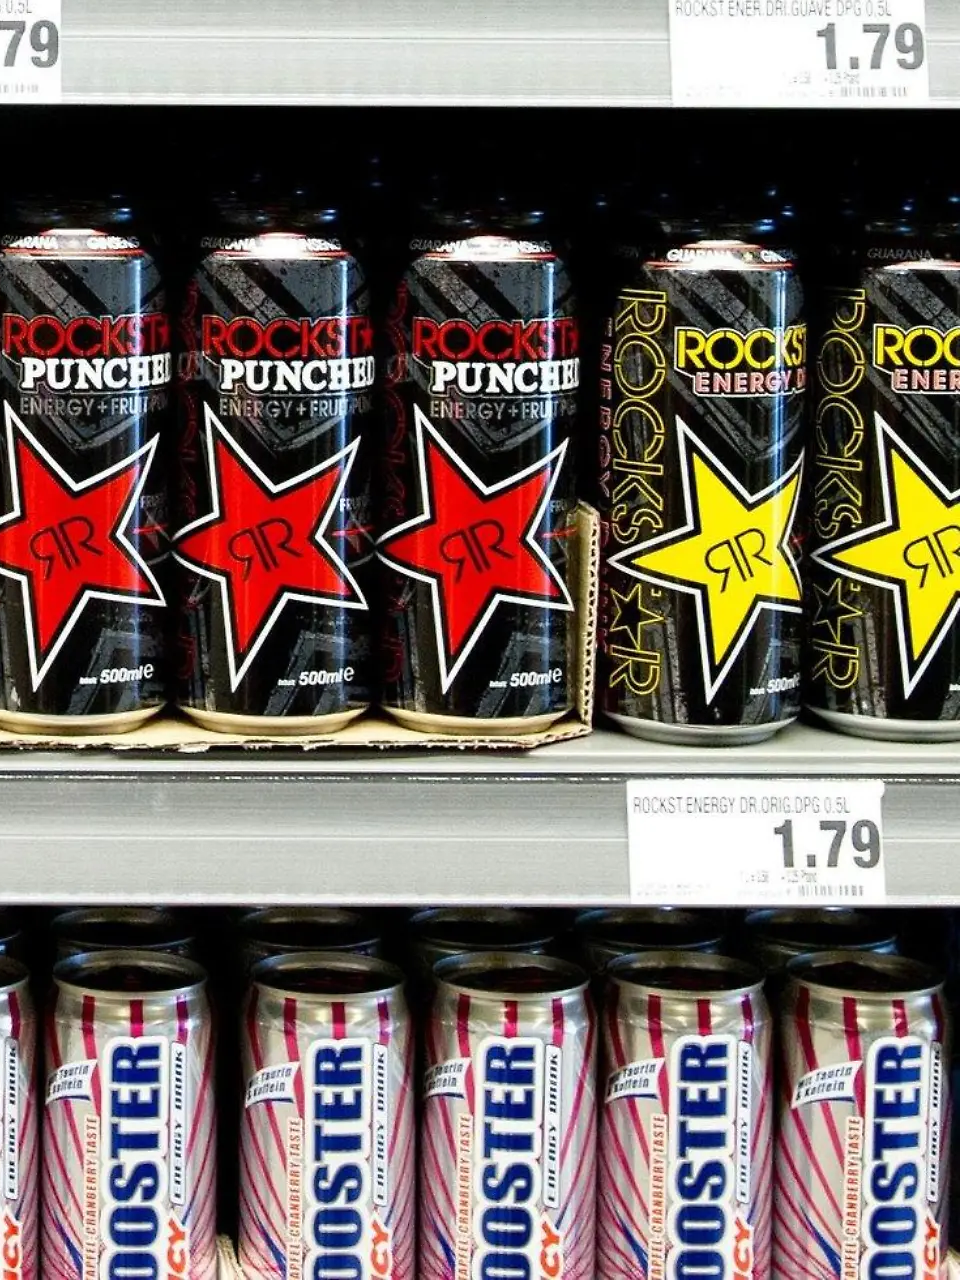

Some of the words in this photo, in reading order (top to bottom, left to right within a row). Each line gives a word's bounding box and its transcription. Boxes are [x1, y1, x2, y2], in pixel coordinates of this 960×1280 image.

[836, 0, 862, 17] DPG
[816, 22, 925, 70] 1.79
[21, 354, 172, 390] PUNCHED
[220, 358, 375, 393] PUNCHED
[695, 372, 792, 395] ENERGY
[20, 397, 91, 417] ENERGY
[219, 399, 292, 419] ENERGY
[430, 400, 503, 420] ENERGY
[774, 819, 880, 869] 1.79
